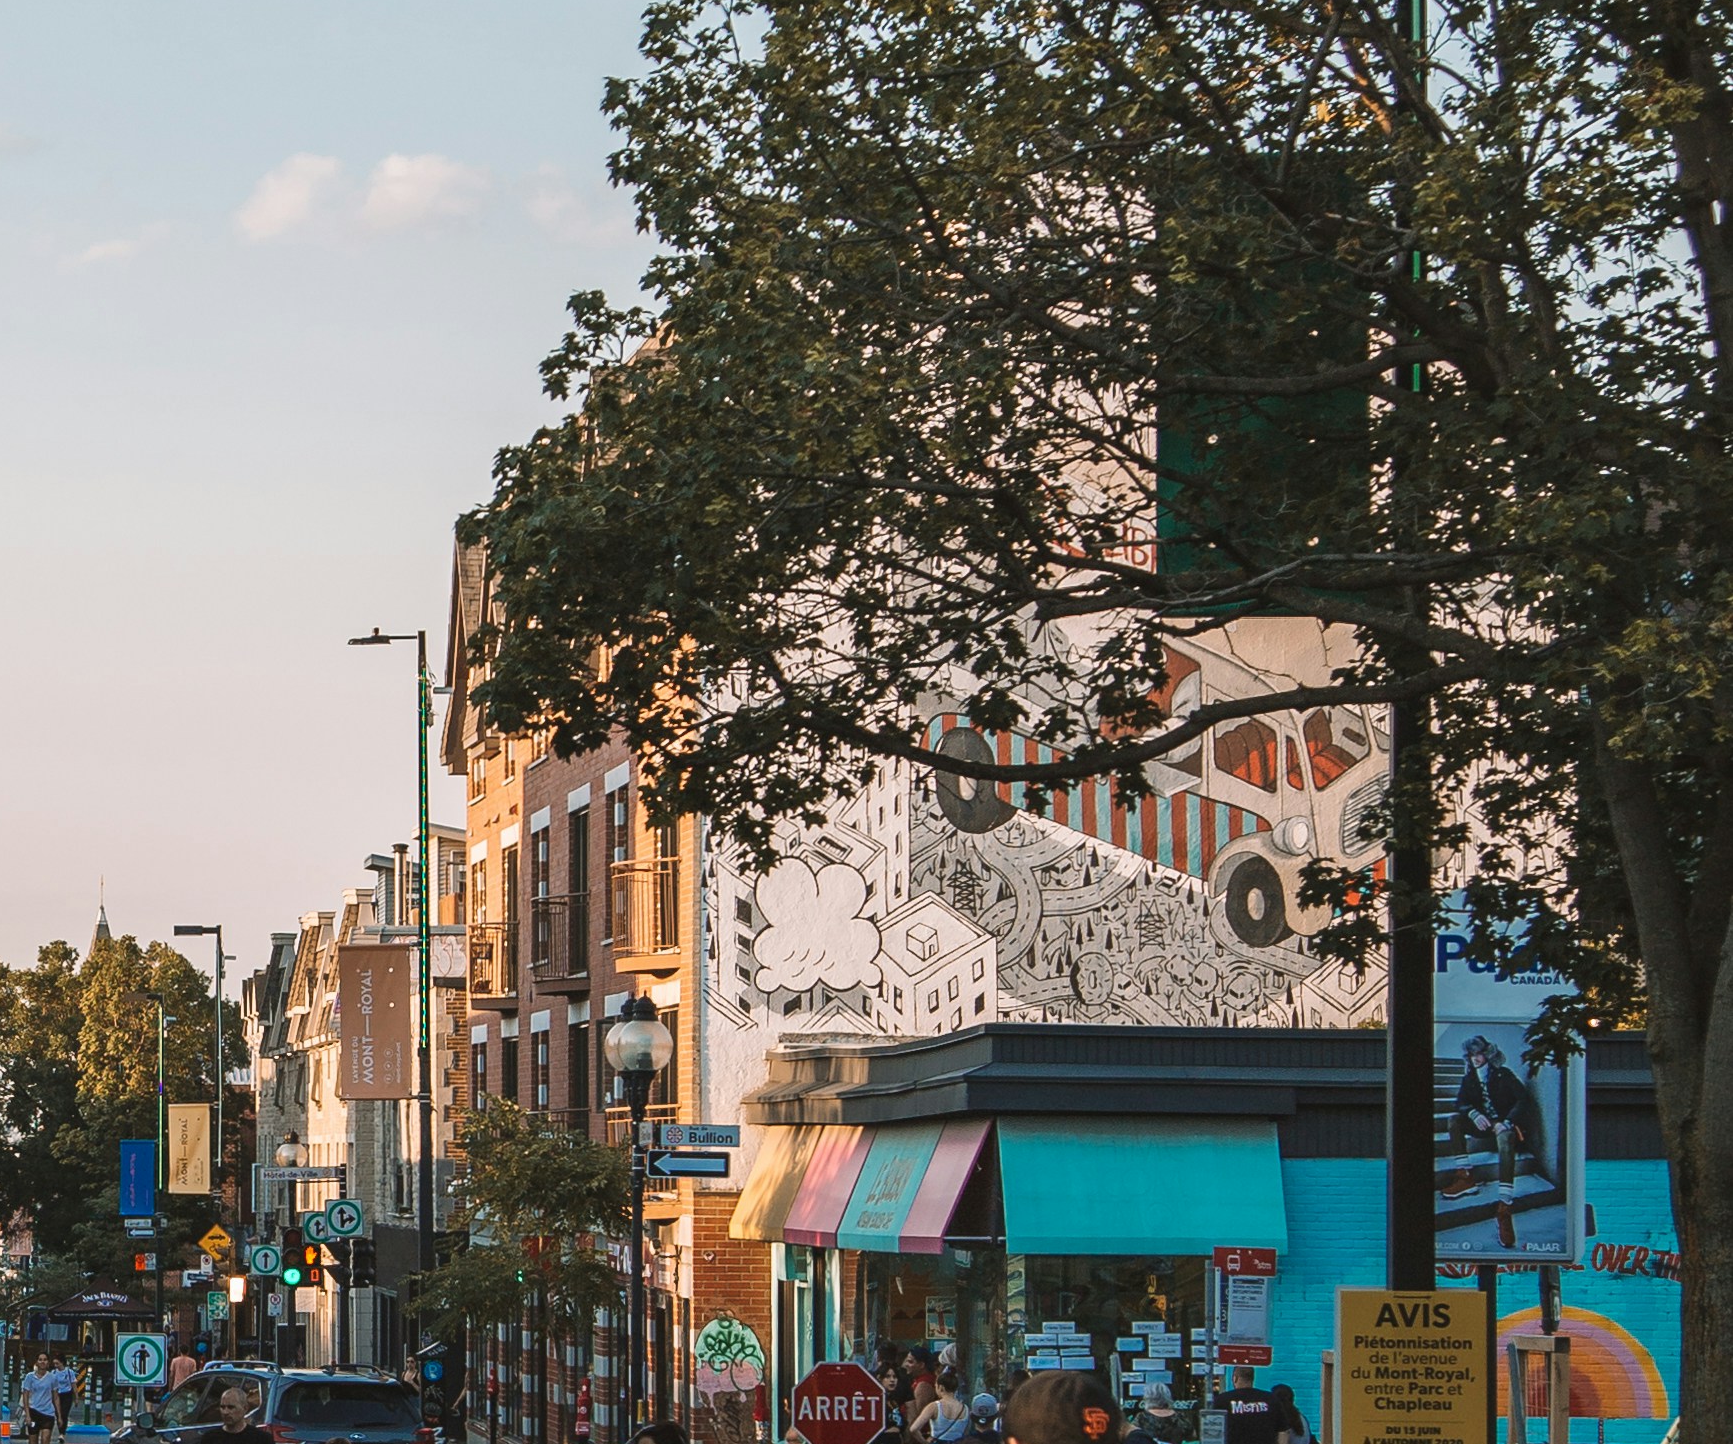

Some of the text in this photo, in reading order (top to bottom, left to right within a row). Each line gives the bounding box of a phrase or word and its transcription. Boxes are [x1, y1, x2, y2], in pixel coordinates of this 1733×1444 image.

[1511, 976, 1561, 985] CANADA
[689, 1132, 733, 1144] Bullion
[1526, 1243, 1560, 1252] PAJAR
[1591, 1242, 1650, 1277] OVER
[1375, 1303, 1451, 1329] AVIS
[1354, 1335, 1473, 1350] Piétonnisation
[1369, 1351, 1458, 1365] de l'avenue
[1351, 1366, 1475, 1383] du Mont-Royal,
[1364, 1382, 1463, 1396] entre Parc et
[798, 1391, 880, 1421] ARRÊT
[1374, 1397, 1452, 1413] Chapleau
[1386, 1426, 1441, 1436] DU 15 JUIN
